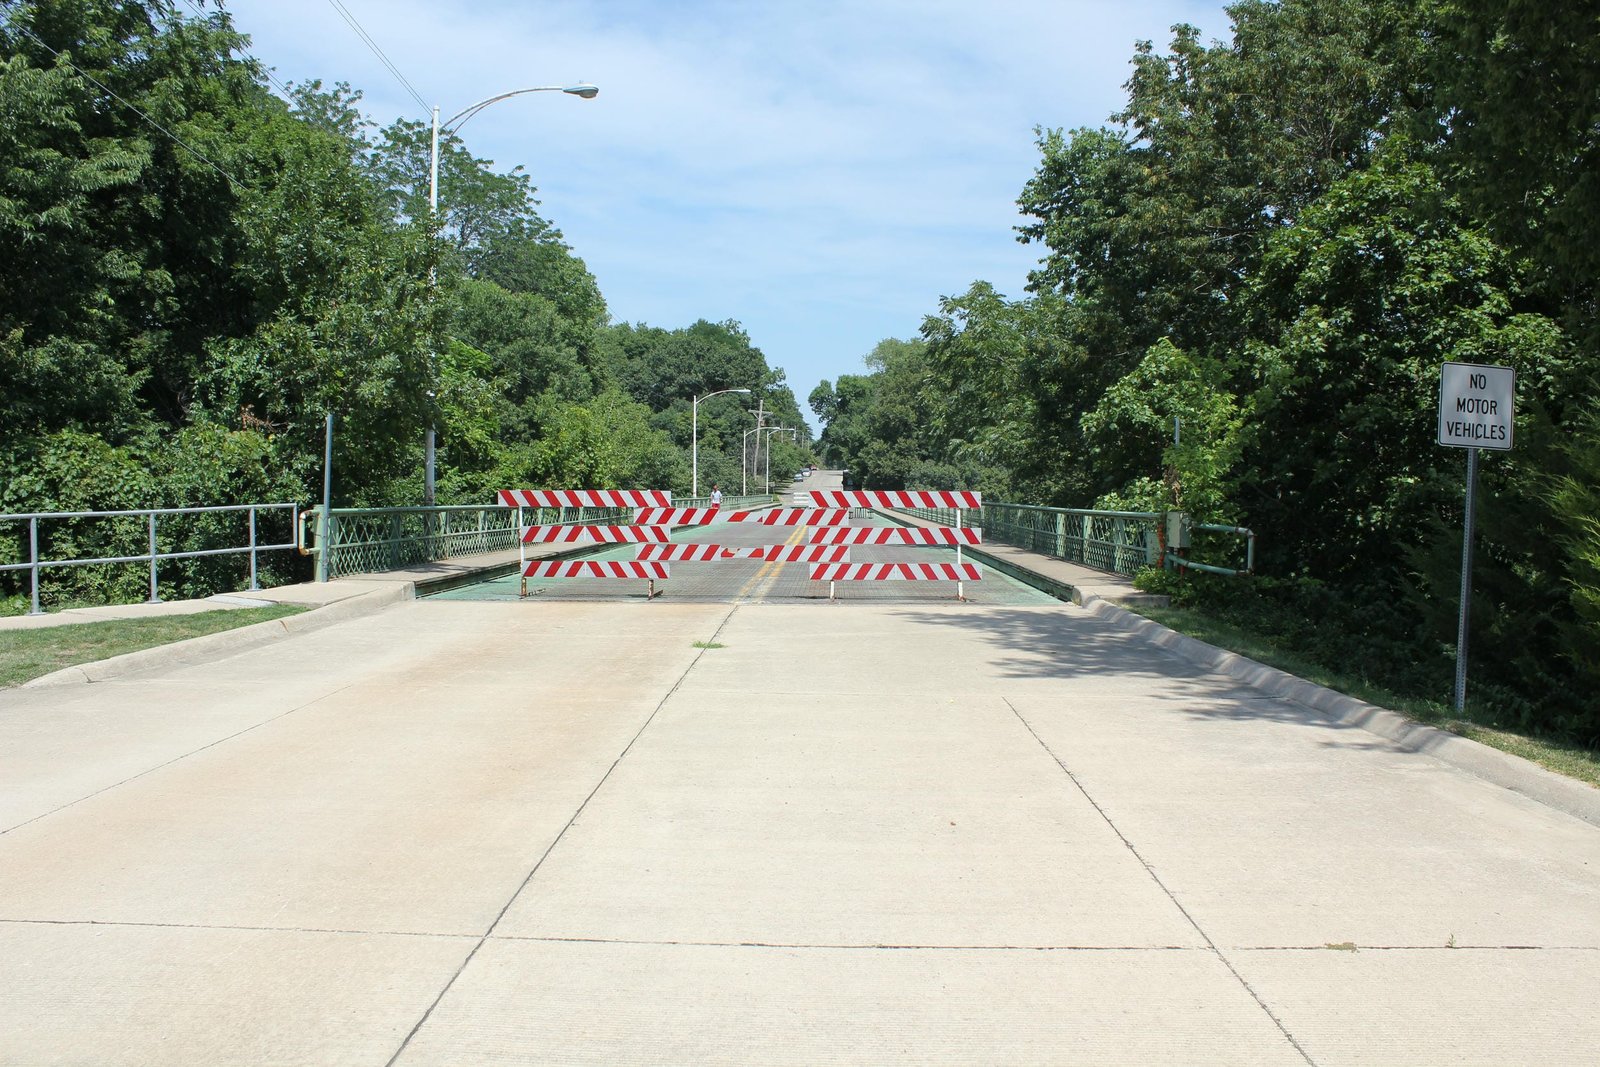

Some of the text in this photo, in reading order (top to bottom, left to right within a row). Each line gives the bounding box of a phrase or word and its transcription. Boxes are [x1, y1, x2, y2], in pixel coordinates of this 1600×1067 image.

[1469, 373, 1487, 390] NO
[1456, 397, 1498, 415] MOTOR
[1446, 421, 1506, 441] VEHICLES
